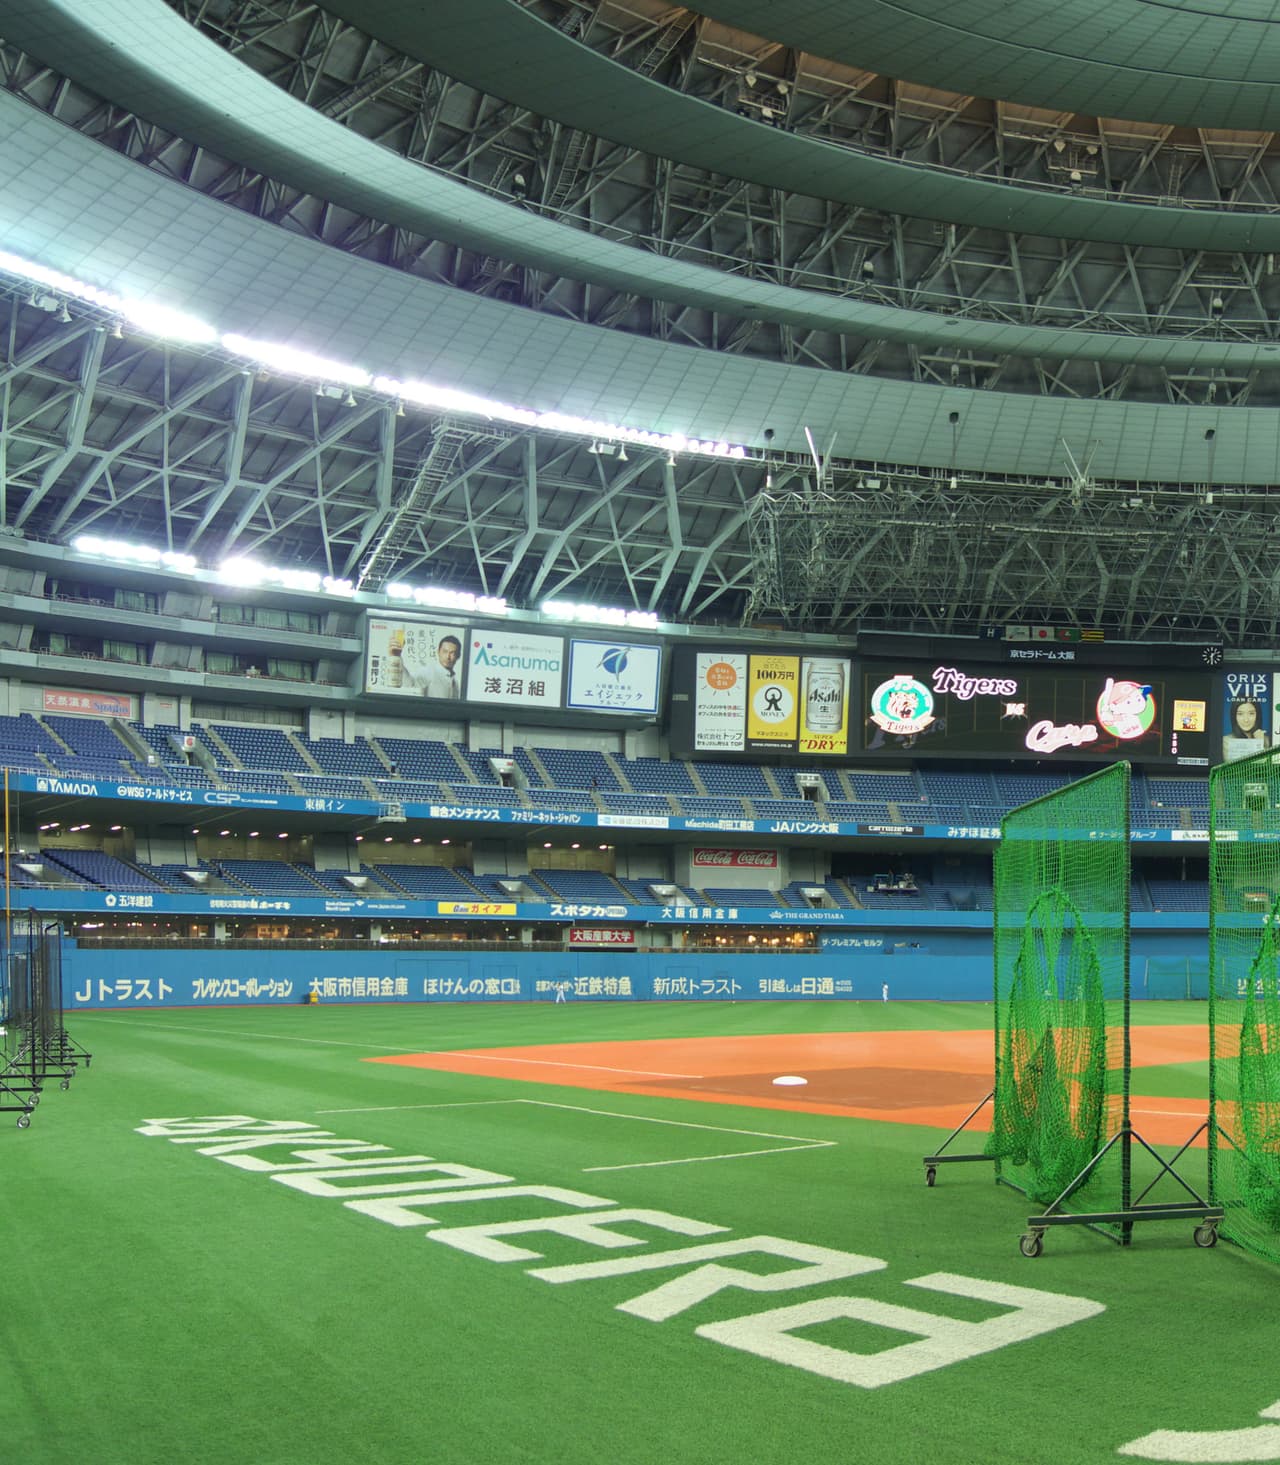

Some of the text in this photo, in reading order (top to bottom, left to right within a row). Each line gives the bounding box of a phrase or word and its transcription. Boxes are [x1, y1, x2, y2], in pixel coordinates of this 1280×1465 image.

[474, 646, 560, 672] Asanuma
[1010, 649, 1075, 661] 京セラドーム 大阪
[756, 669, 794, 680] 100万円
[1227, 674, 1267, 684] ORIX
[932, 667, 1017, 699] Tigers
[584, 689, 643, 701] エイジェック
[810, 689, 840, 703] Asahi
[1228, 684, 1267, 697] VIP
[49, 779, 98, 796] YAMADA
[127, 786, 193, 802] WSG ワールドサービス
[204, 792, 240, 804] CSP
[305, 799, 345, 811] 東横イン
[430, 806, 500, 821] 総合メンテナンス
[512, 811, 581, 824] ファミリーネット・ジャパン
[770, 821, 839, 834] JAバンク大阪
[868, 825, 913, 833] carrozzeria
[948, 826, 1001, 839] みずほ証券
[471, 904, 502, 913] ガイア
[550, 904, 606, 916] スポタカ
[662, 907, 739, 920] 大阪信用金庫
[573, 930, 631, 942] 大阪産業大学
[822, 938, 883, 948] ザ・プレミアム・モルツ
[75, 978, 173, 1001] Jトラスト
[192, 978, 293, 999] プレサンスコーポレーション
[309, 977, 409, 998] 大阪市信用金庫
[423, 978, 514, 995] ほけんの窓口
[574, 977, 632, 996] 近鉄特急
[653, 977, 742, 996] 新成トラスト
[759, 977, 834, 995] 引越しは日通
